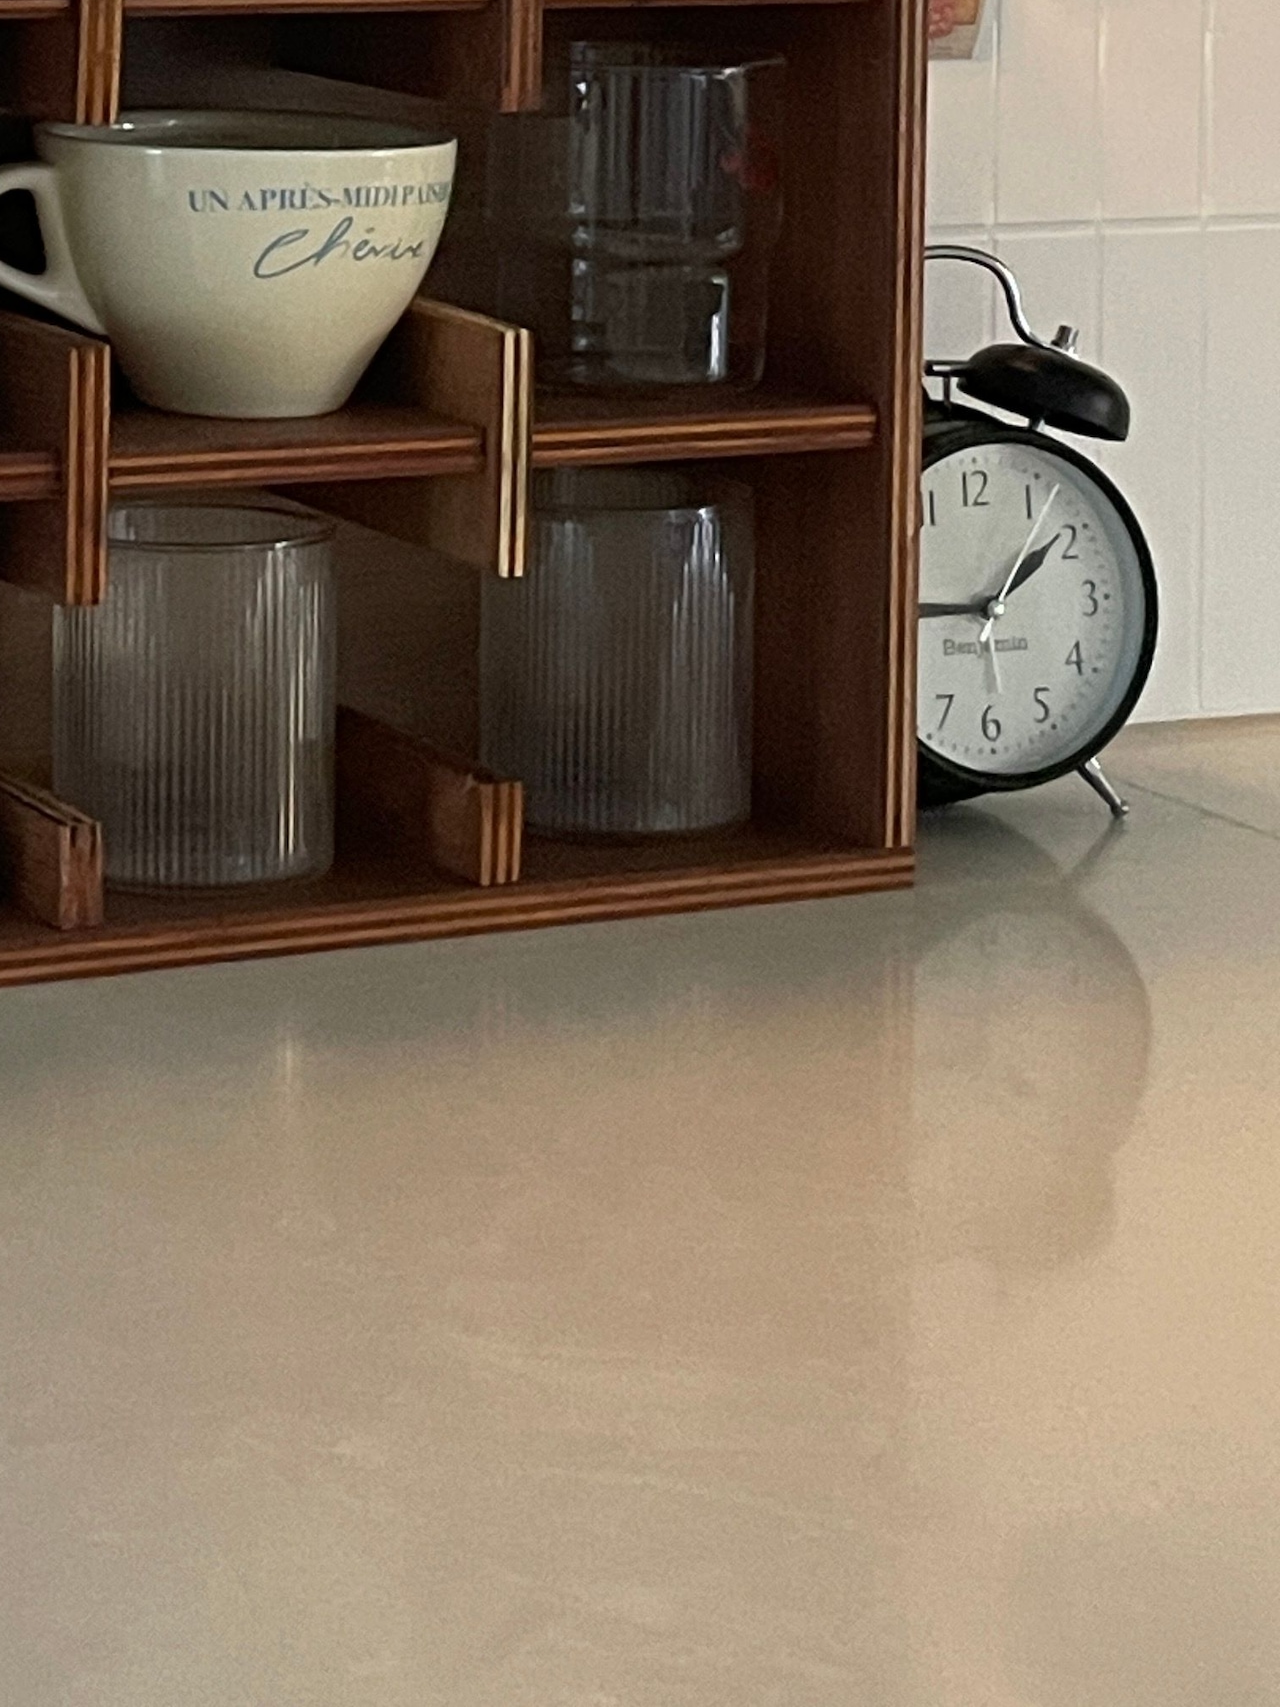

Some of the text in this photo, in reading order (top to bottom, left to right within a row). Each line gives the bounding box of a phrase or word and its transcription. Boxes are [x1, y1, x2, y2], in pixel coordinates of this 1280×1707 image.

[188, 189, 229, 212] UN
[961, 470, 990, 507] 12
[1025, 484, 1033, 520] 1
[1061, 524, 1079, 560] 2
[1082, 580, 1099, 617] 3
[1065, 640, 1084, 676] 4
[934, 694, 955, 731] 7
[980, 704, 1002, 741] 6
[1033, 687, 1051, 724] 5
